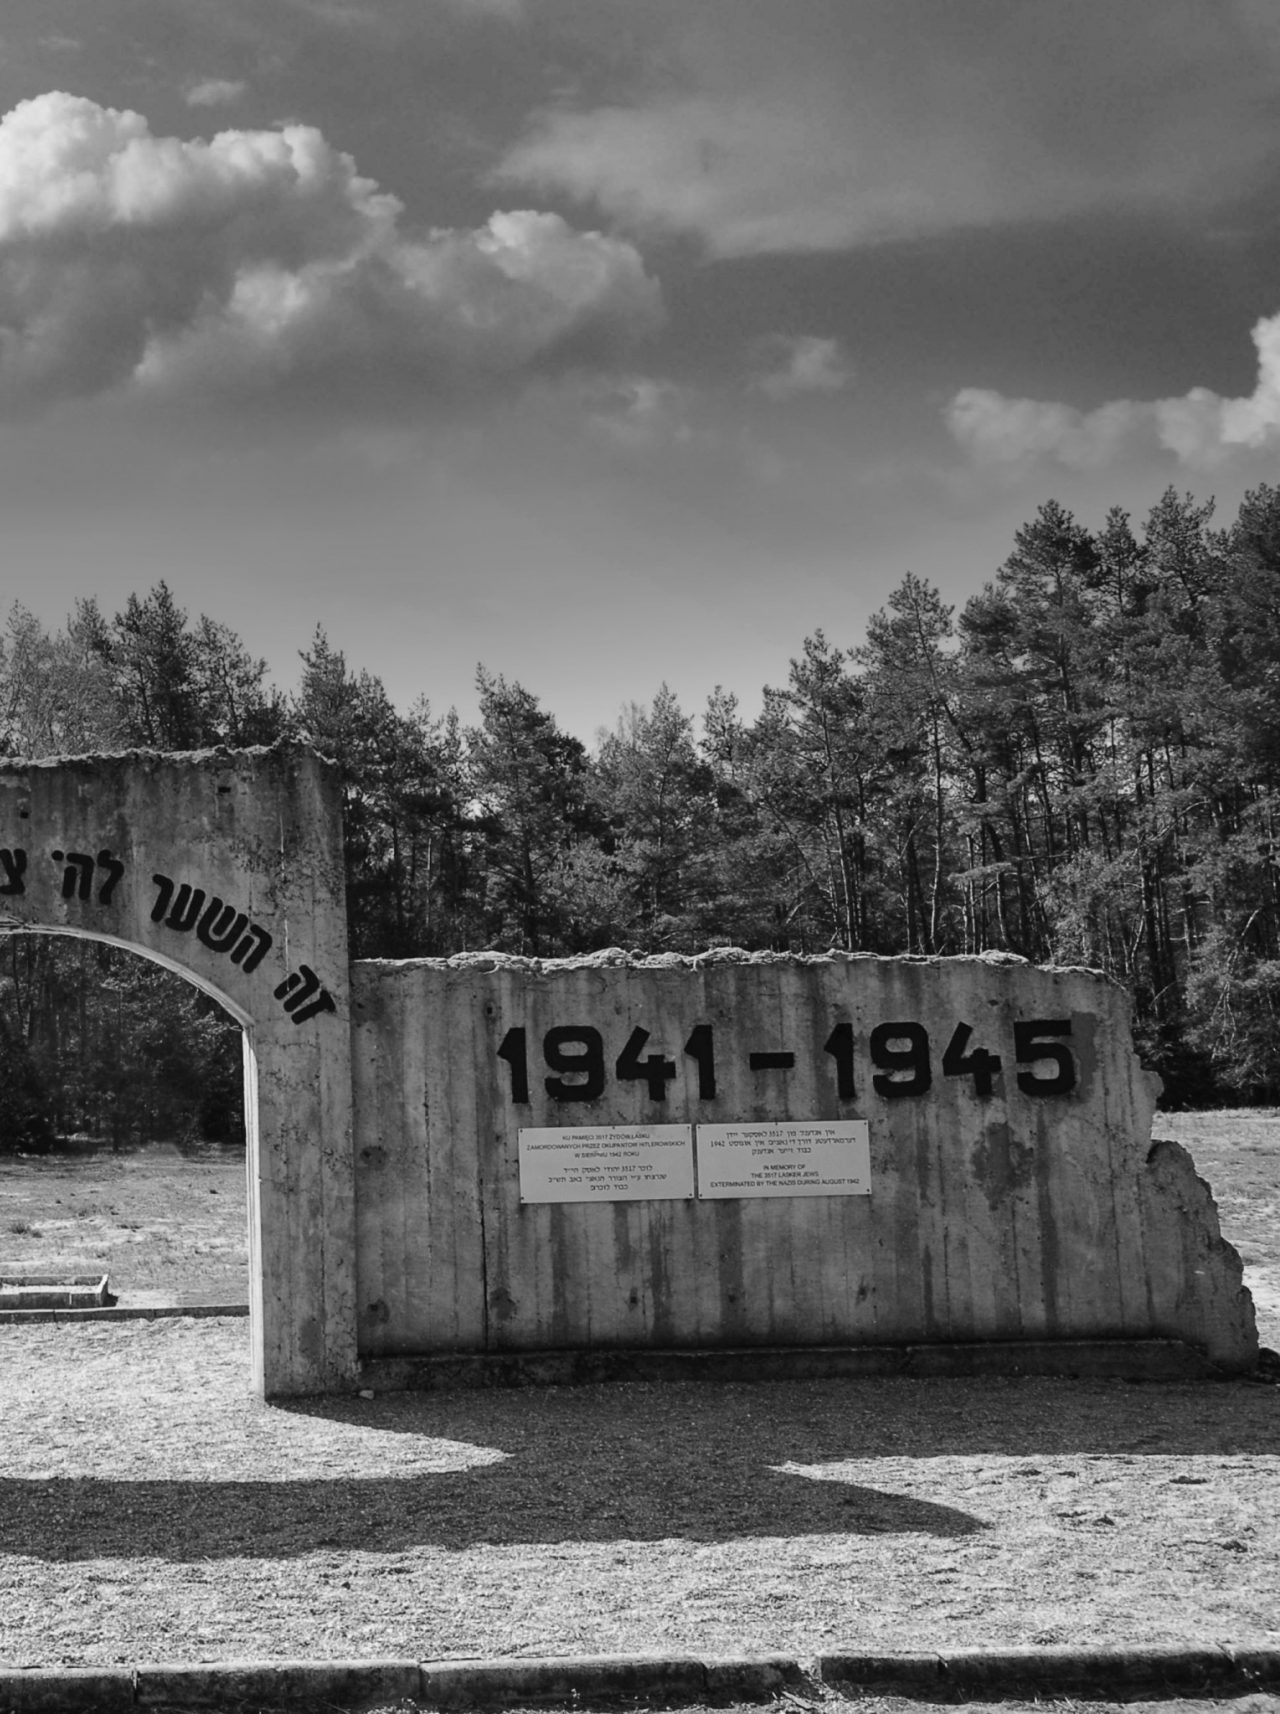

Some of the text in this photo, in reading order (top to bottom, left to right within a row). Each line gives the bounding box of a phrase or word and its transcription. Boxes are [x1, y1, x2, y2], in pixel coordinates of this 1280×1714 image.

[151, 872, 274, 974] השער
[273, 964, 337, 1026] זה
[497, 1023, 717, 1104] 1941
[824, 1018, 1077, 1101] 1945
